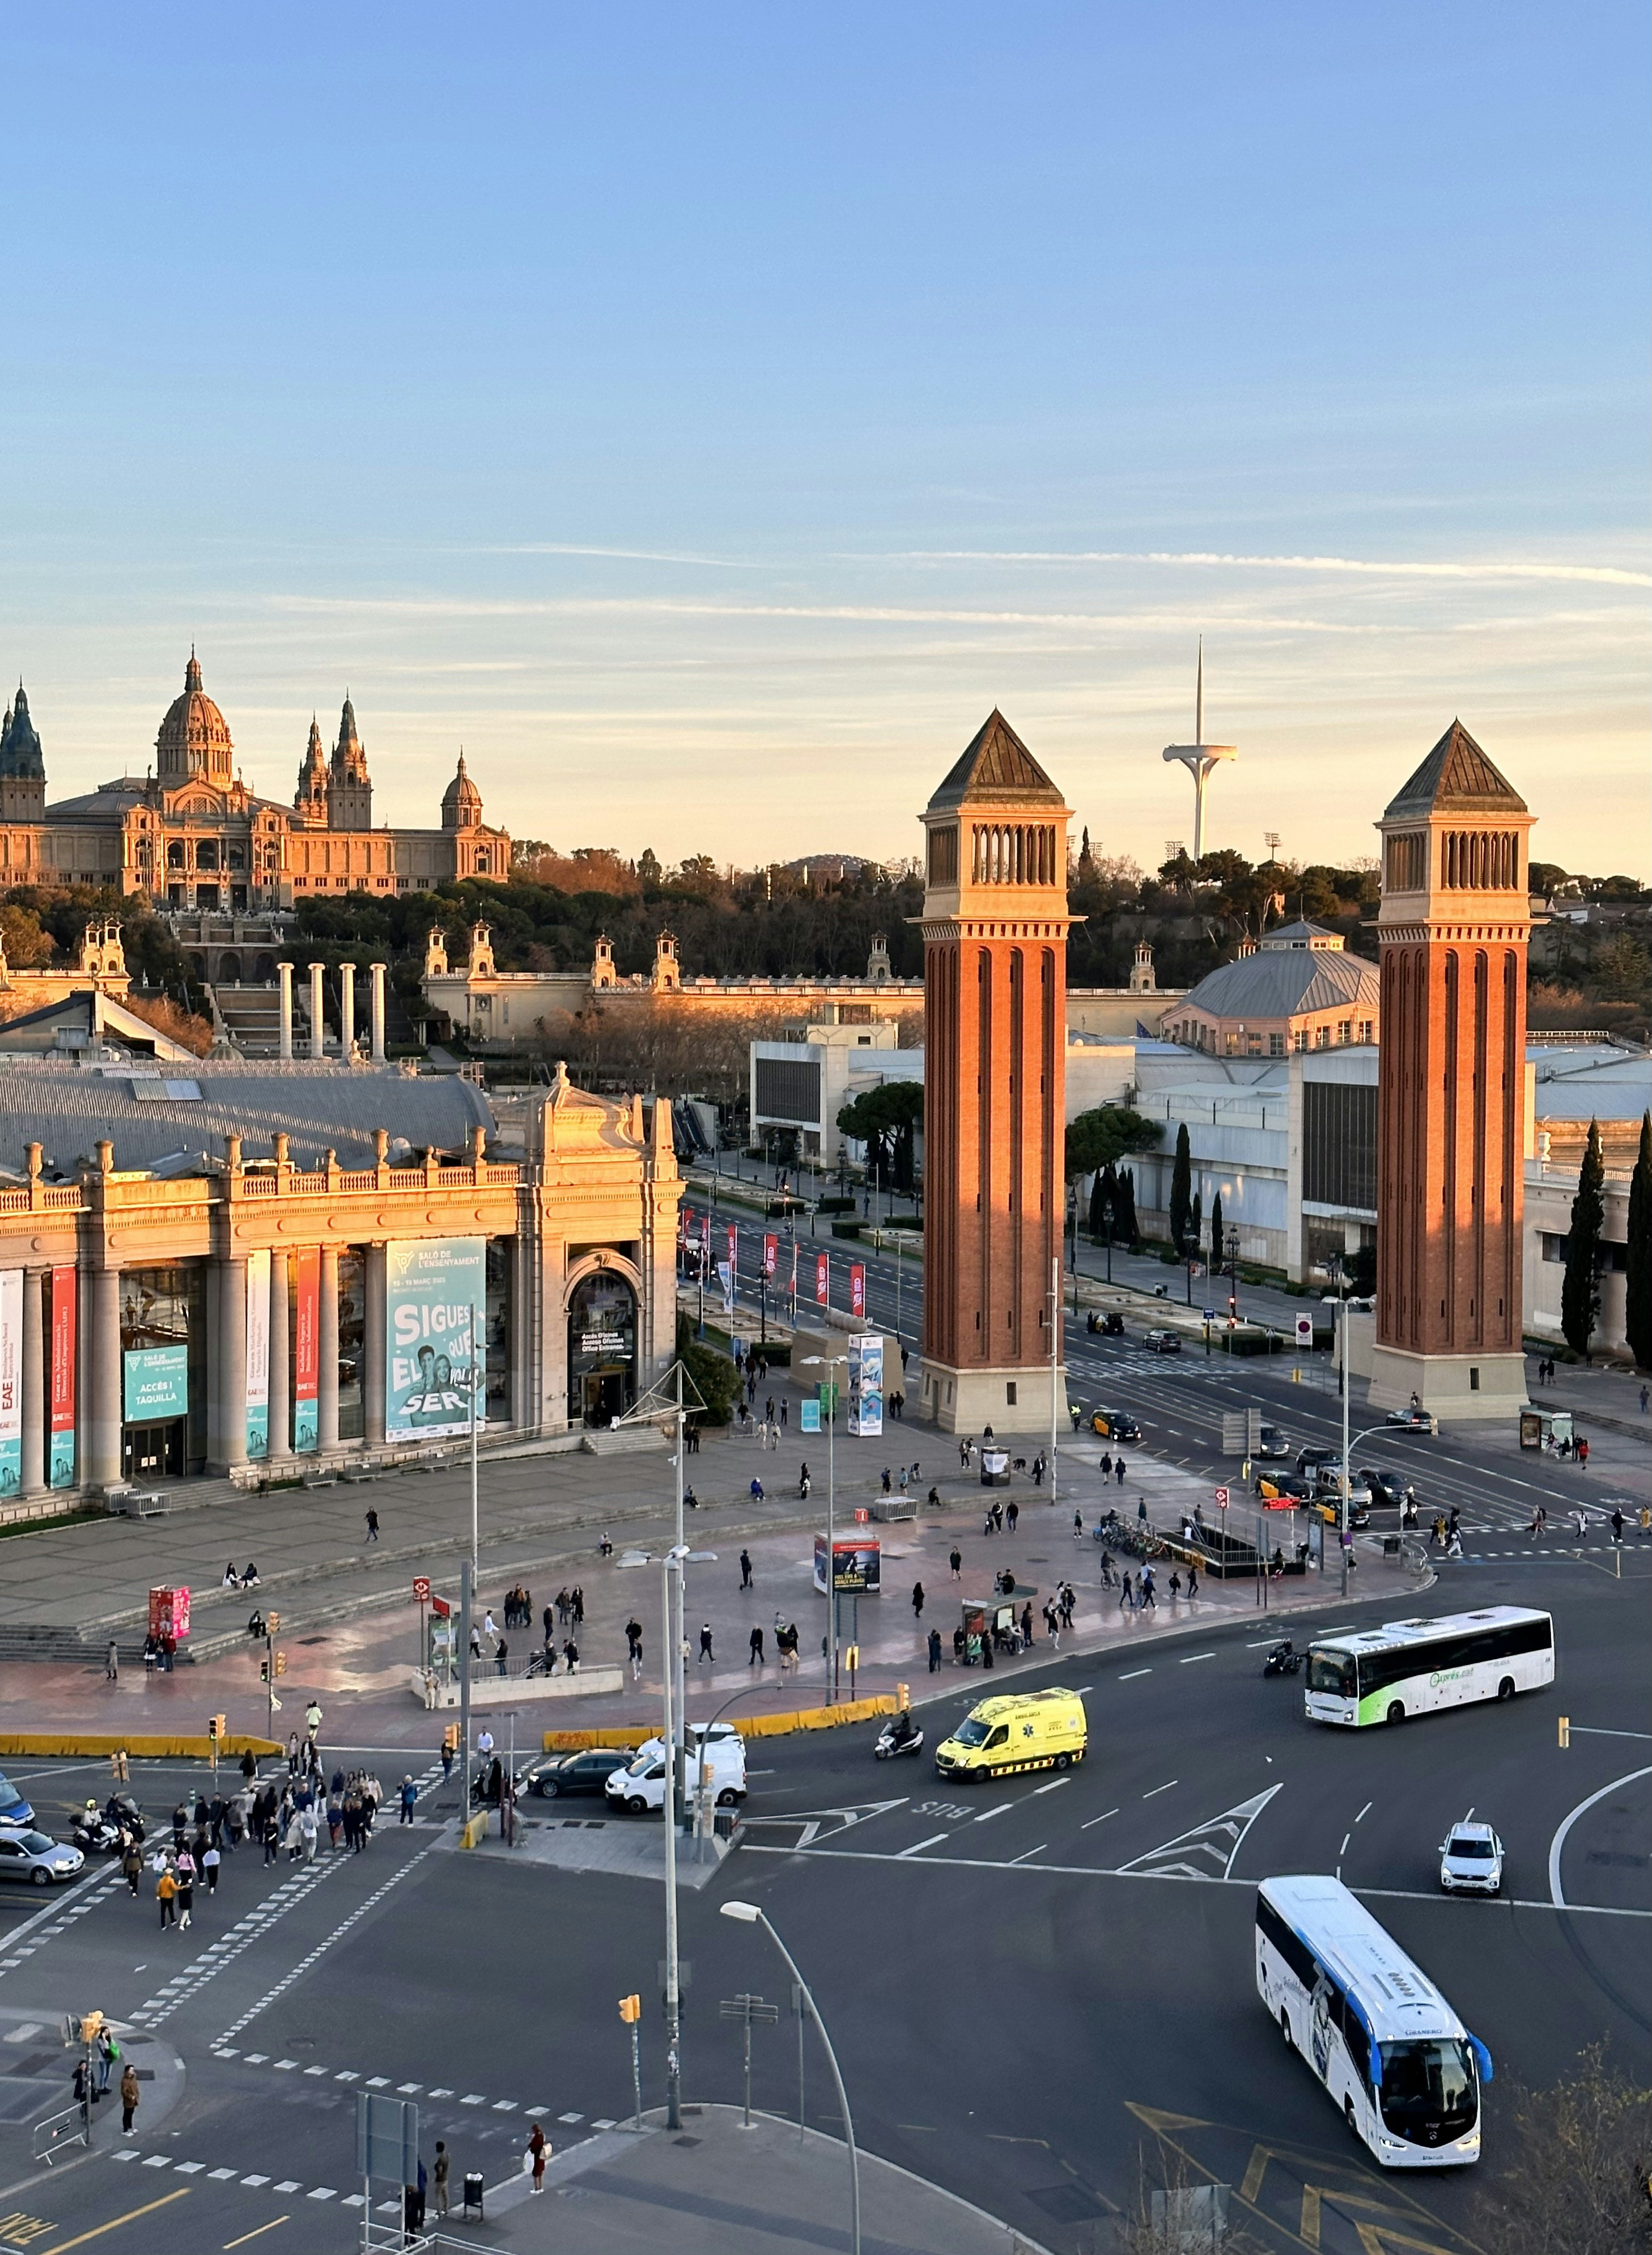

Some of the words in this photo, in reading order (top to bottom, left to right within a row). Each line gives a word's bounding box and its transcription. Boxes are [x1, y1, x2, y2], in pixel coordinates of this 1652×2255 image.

[418, 1250, 438, 1260] SALÓ
[418, 1257, 479, 1268] L'ENSENYAMENT
[394, 1304, 469, 1345] SIGUES
[393, 1358, 422, 1392] EL
[140, 1380, 168, 1392] ACCÉS
[169, 1380, 172, 1389] I
[2, 1381, 12, 1410] EAE
[136, 1392, 177, 1405] TAQUILLA
[398, 1391, 469, 1414] SER
[911, 1802, 976, 1819] BUS
